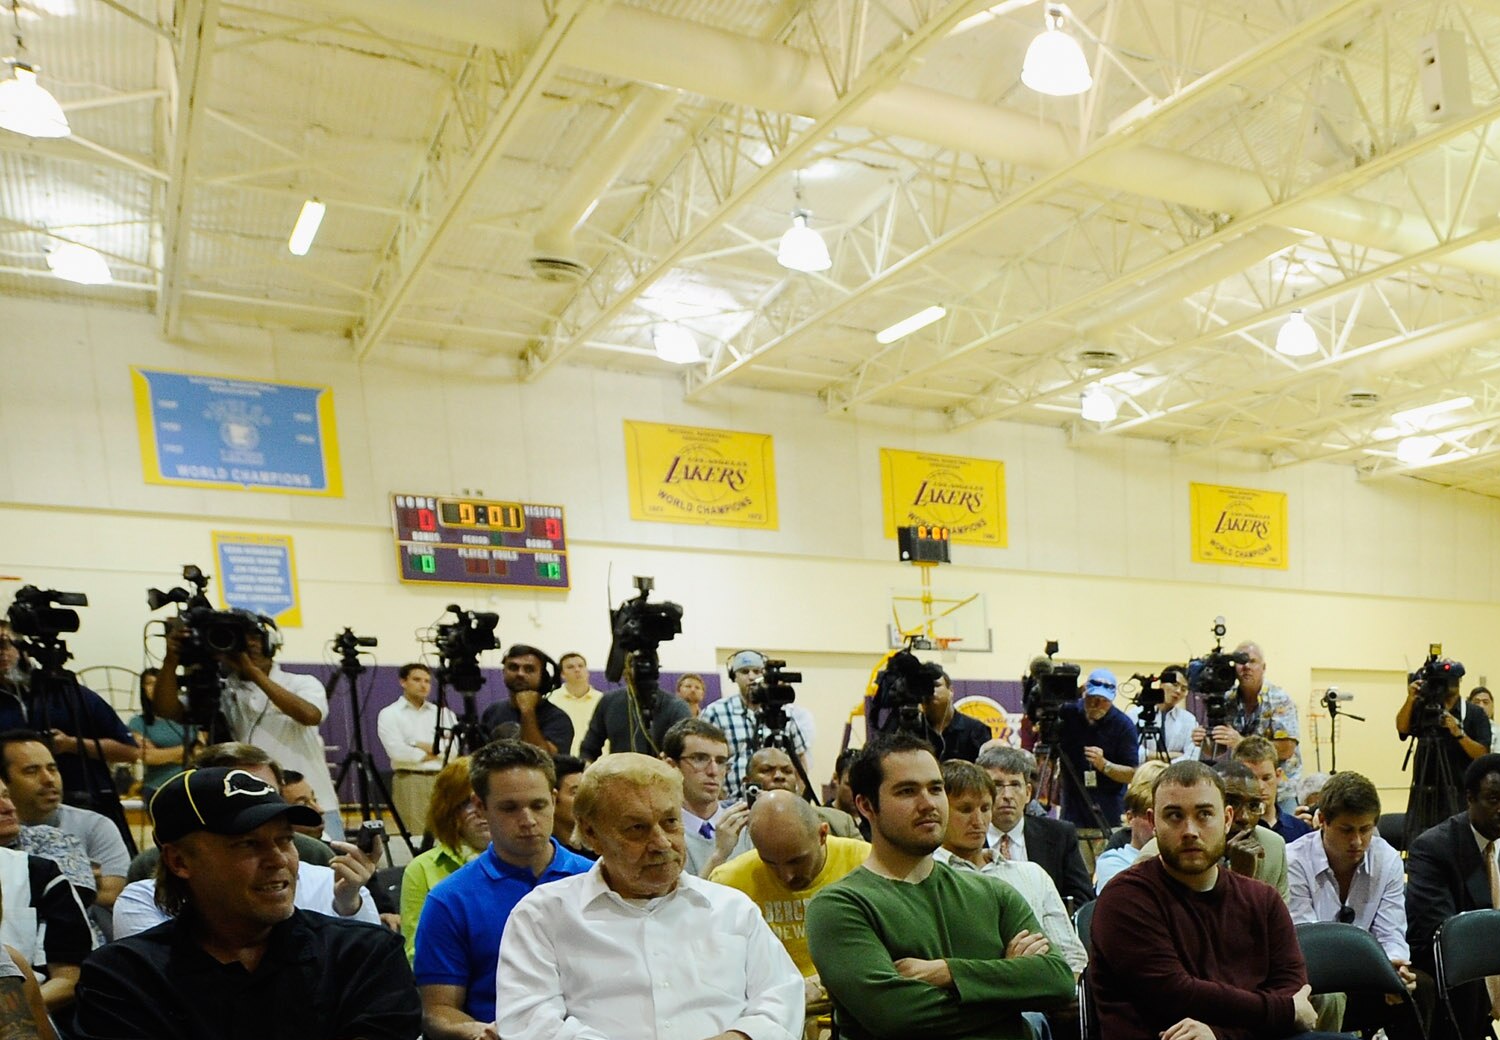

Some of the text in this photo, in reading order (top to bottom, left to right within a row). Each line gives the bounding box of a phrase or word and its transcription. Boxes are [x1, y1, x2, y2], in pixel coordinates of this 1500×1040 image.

[176, 464, 312, 487] WORLD CHAMPIONS
[664, 456, 748, 492] LAKERS
[396, 495, 436, 510] HOME
[657, 489, 753, 515] WORLD CHAMPIONS
[914, 481, 984, 514] LAKERS
[524, 505, 562, 518] VISITOR
[1214, 511, 1270, 540] LAKERS
